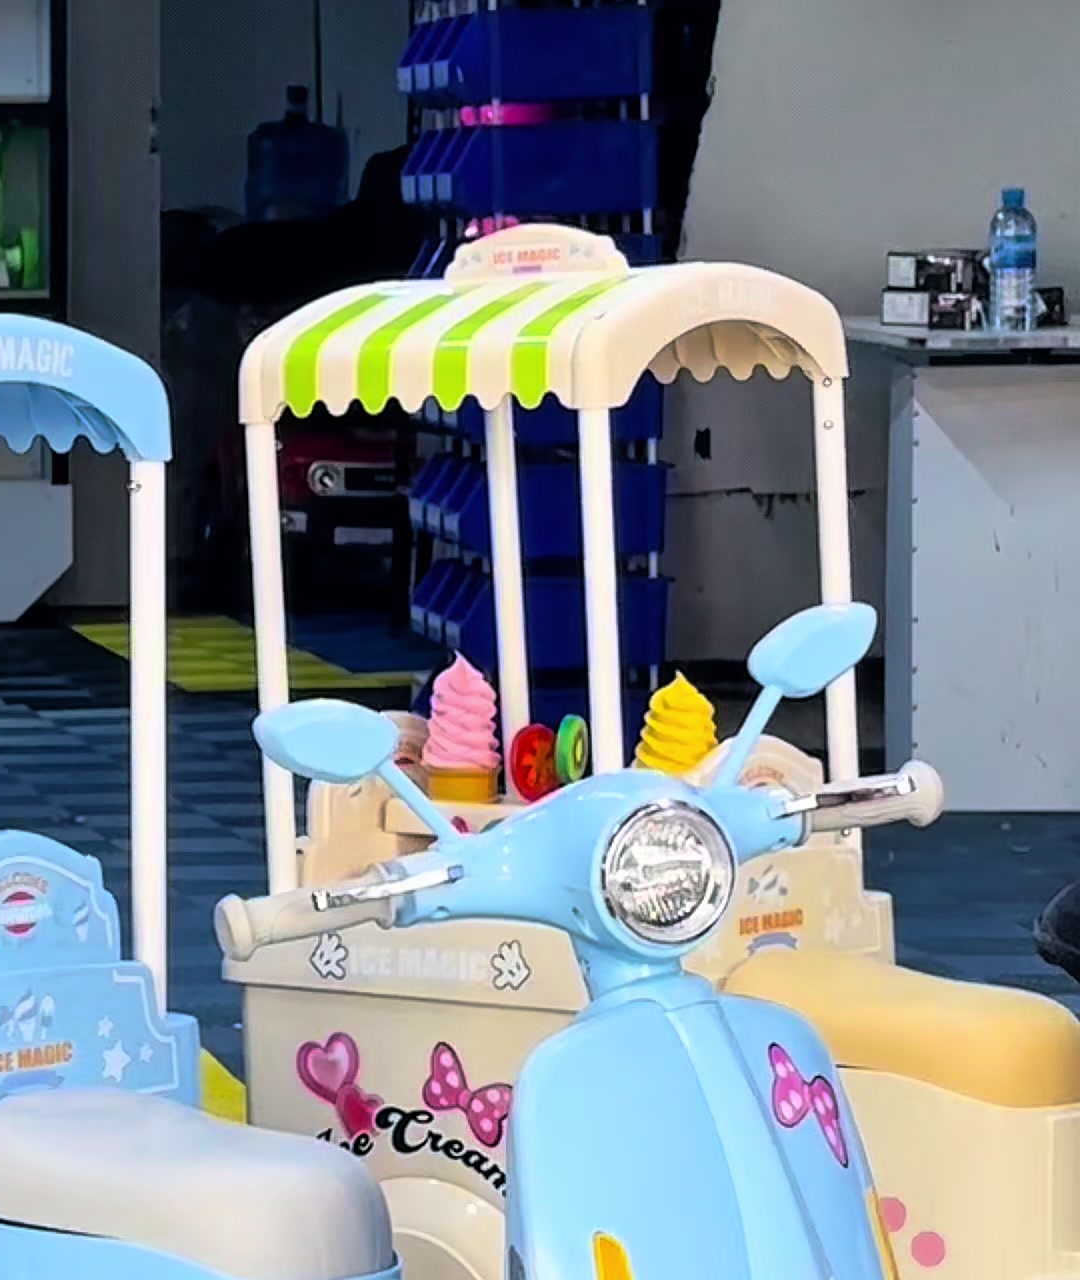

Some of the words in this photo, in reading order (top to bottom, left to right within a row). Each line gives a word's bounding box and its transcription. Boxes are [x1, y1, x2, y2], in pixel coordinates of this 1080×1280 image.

[762, 907, 803, 932] MAGIC
[397, 946, 488, 982] MAGIC
[17, 1040, 73, 1069] MAGIC
